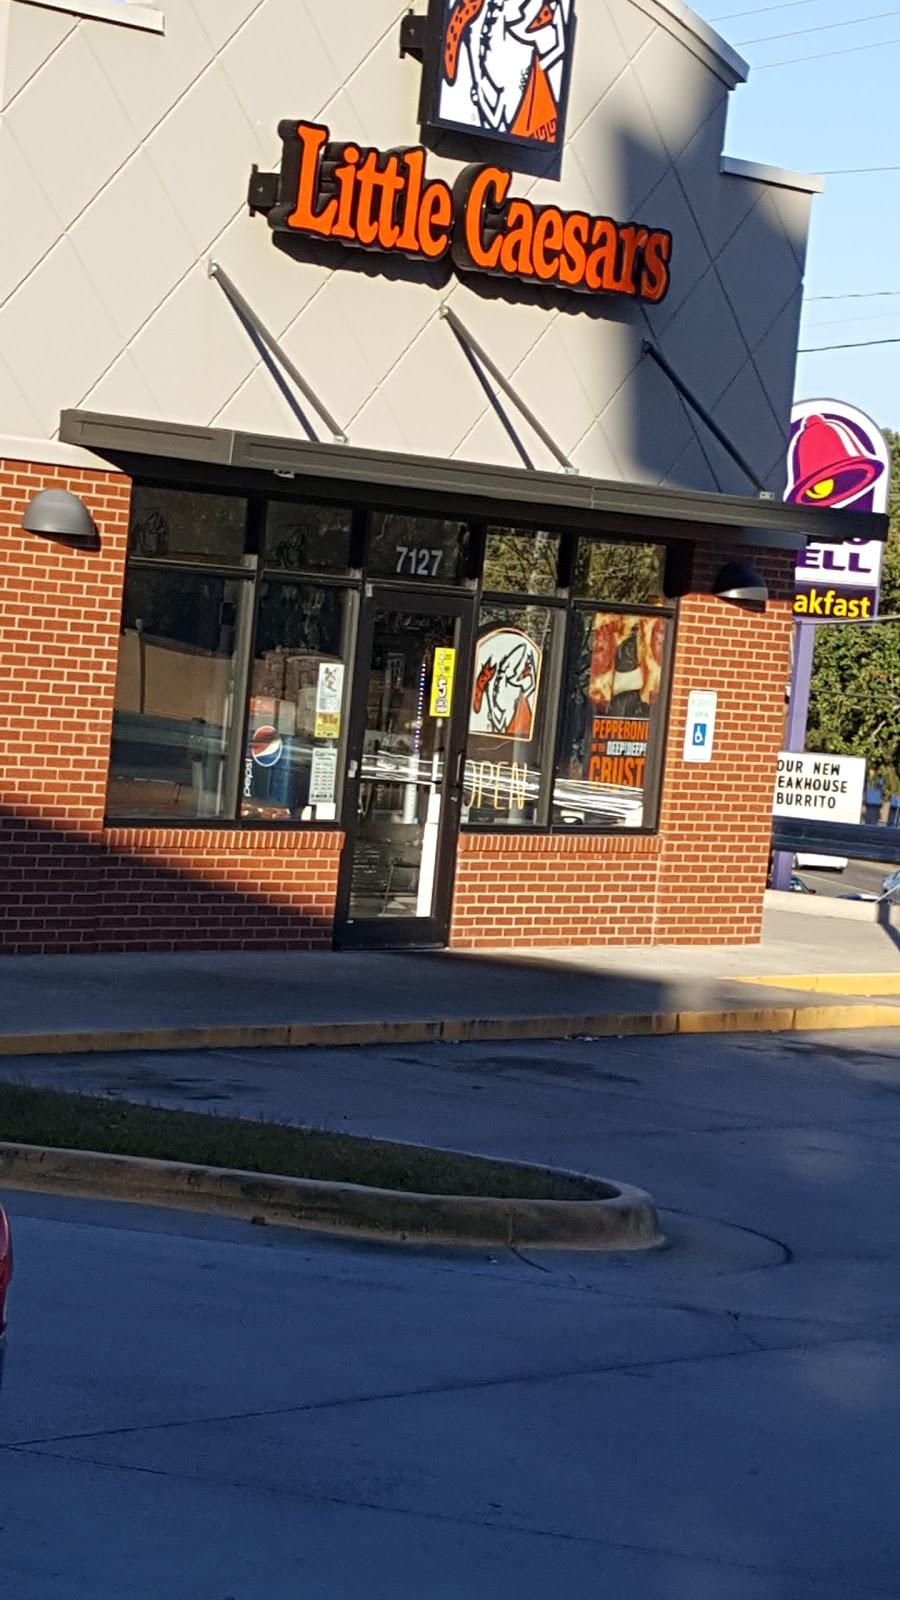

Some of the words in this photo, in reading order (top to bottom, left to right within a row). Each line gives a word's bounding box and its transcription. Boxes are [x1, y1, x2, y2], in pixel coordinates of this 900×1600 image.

[288, 124, 452, 257] Little
[464, 166, 671, 300] Caesars
[396, 546, 443, 576] 7127
[592, 719, 650, 741] PEPPERONI
[243, 757, 254, 797] pepsi
[588, 756, 646, 789] CRUST
[813, 762, 841, 776] NEW
[777, 775, 848, 793] EAKHOUSE
[776, 791, 837, 809] BURRITO
